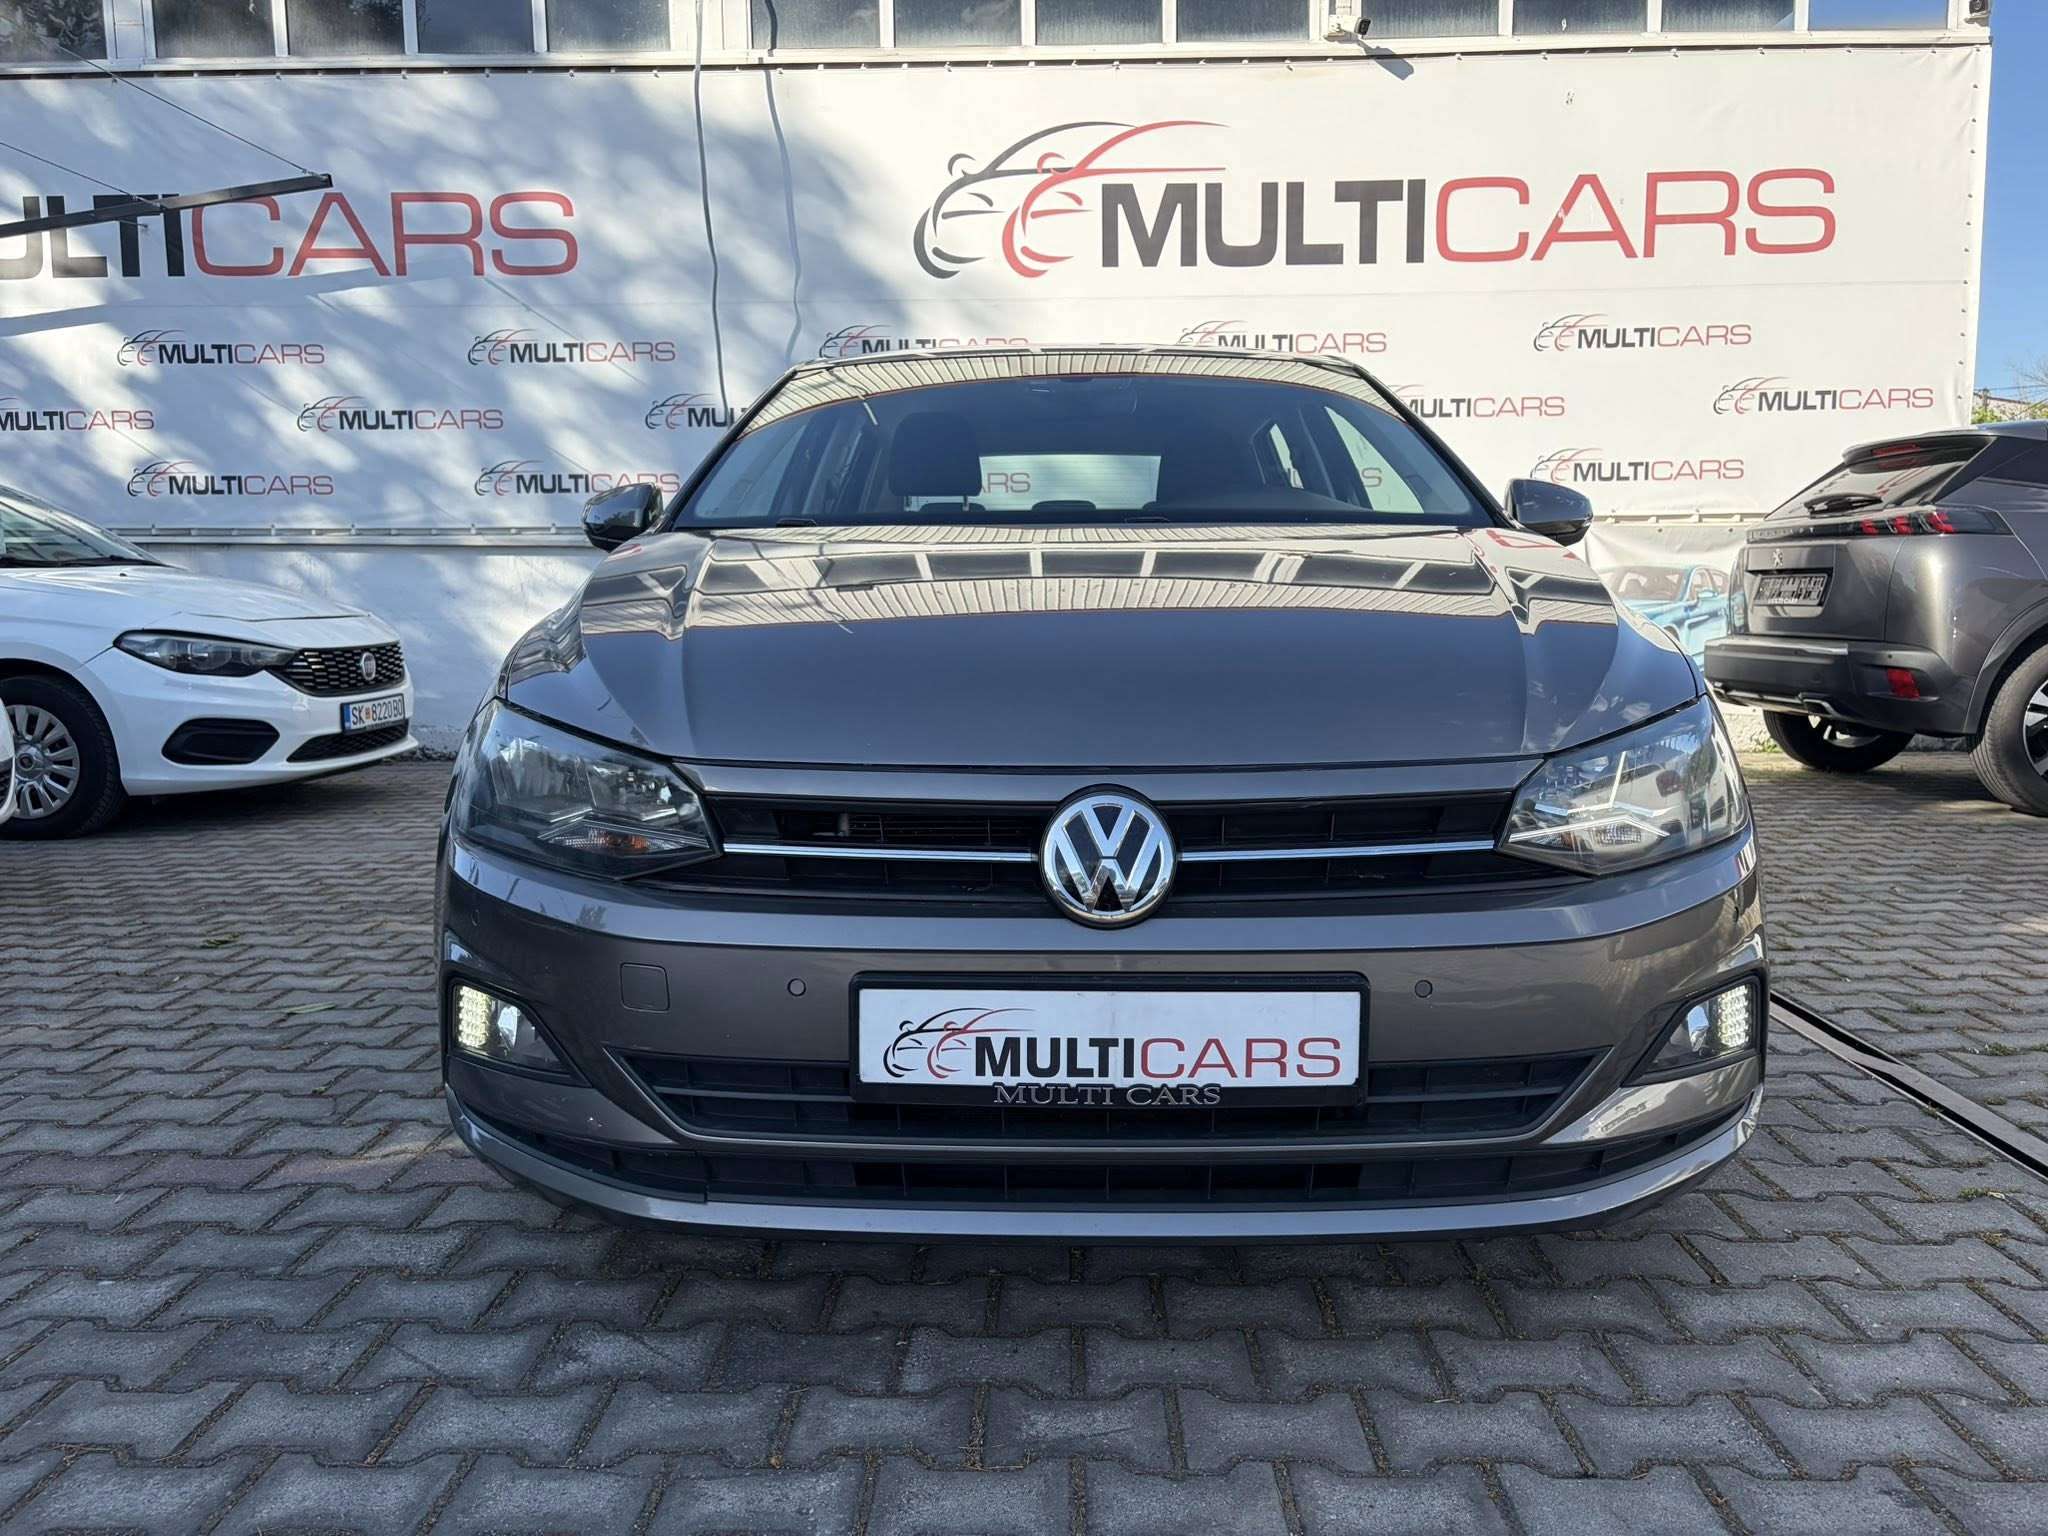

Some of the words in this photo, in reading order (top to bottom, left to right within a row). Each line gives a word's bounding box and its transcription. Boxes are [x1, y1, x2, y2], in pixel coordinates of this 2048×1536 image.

[1101, 168, 1836, 268] MULTICARS
[1577, 324, 1752, 349] MULTICARS
[158, 343, 325, 366] MULTICARS
[509, 341, 676, 364] MULTICARS
[1758, 387, 1934, 412] MULTICARS
[338, 408, 503, 431] MULTICARS
[1573, 459, 1744, 483] MULTICARS
[168, 474, 334, 497] MULTICARS
[352, 706, 366, 726] SK
[975, 1036, 1342, 1079] MULTICARS
[993, 1084, 1113, 1106] MULTI
[1125, 1084, 1222, 1106] CARS
